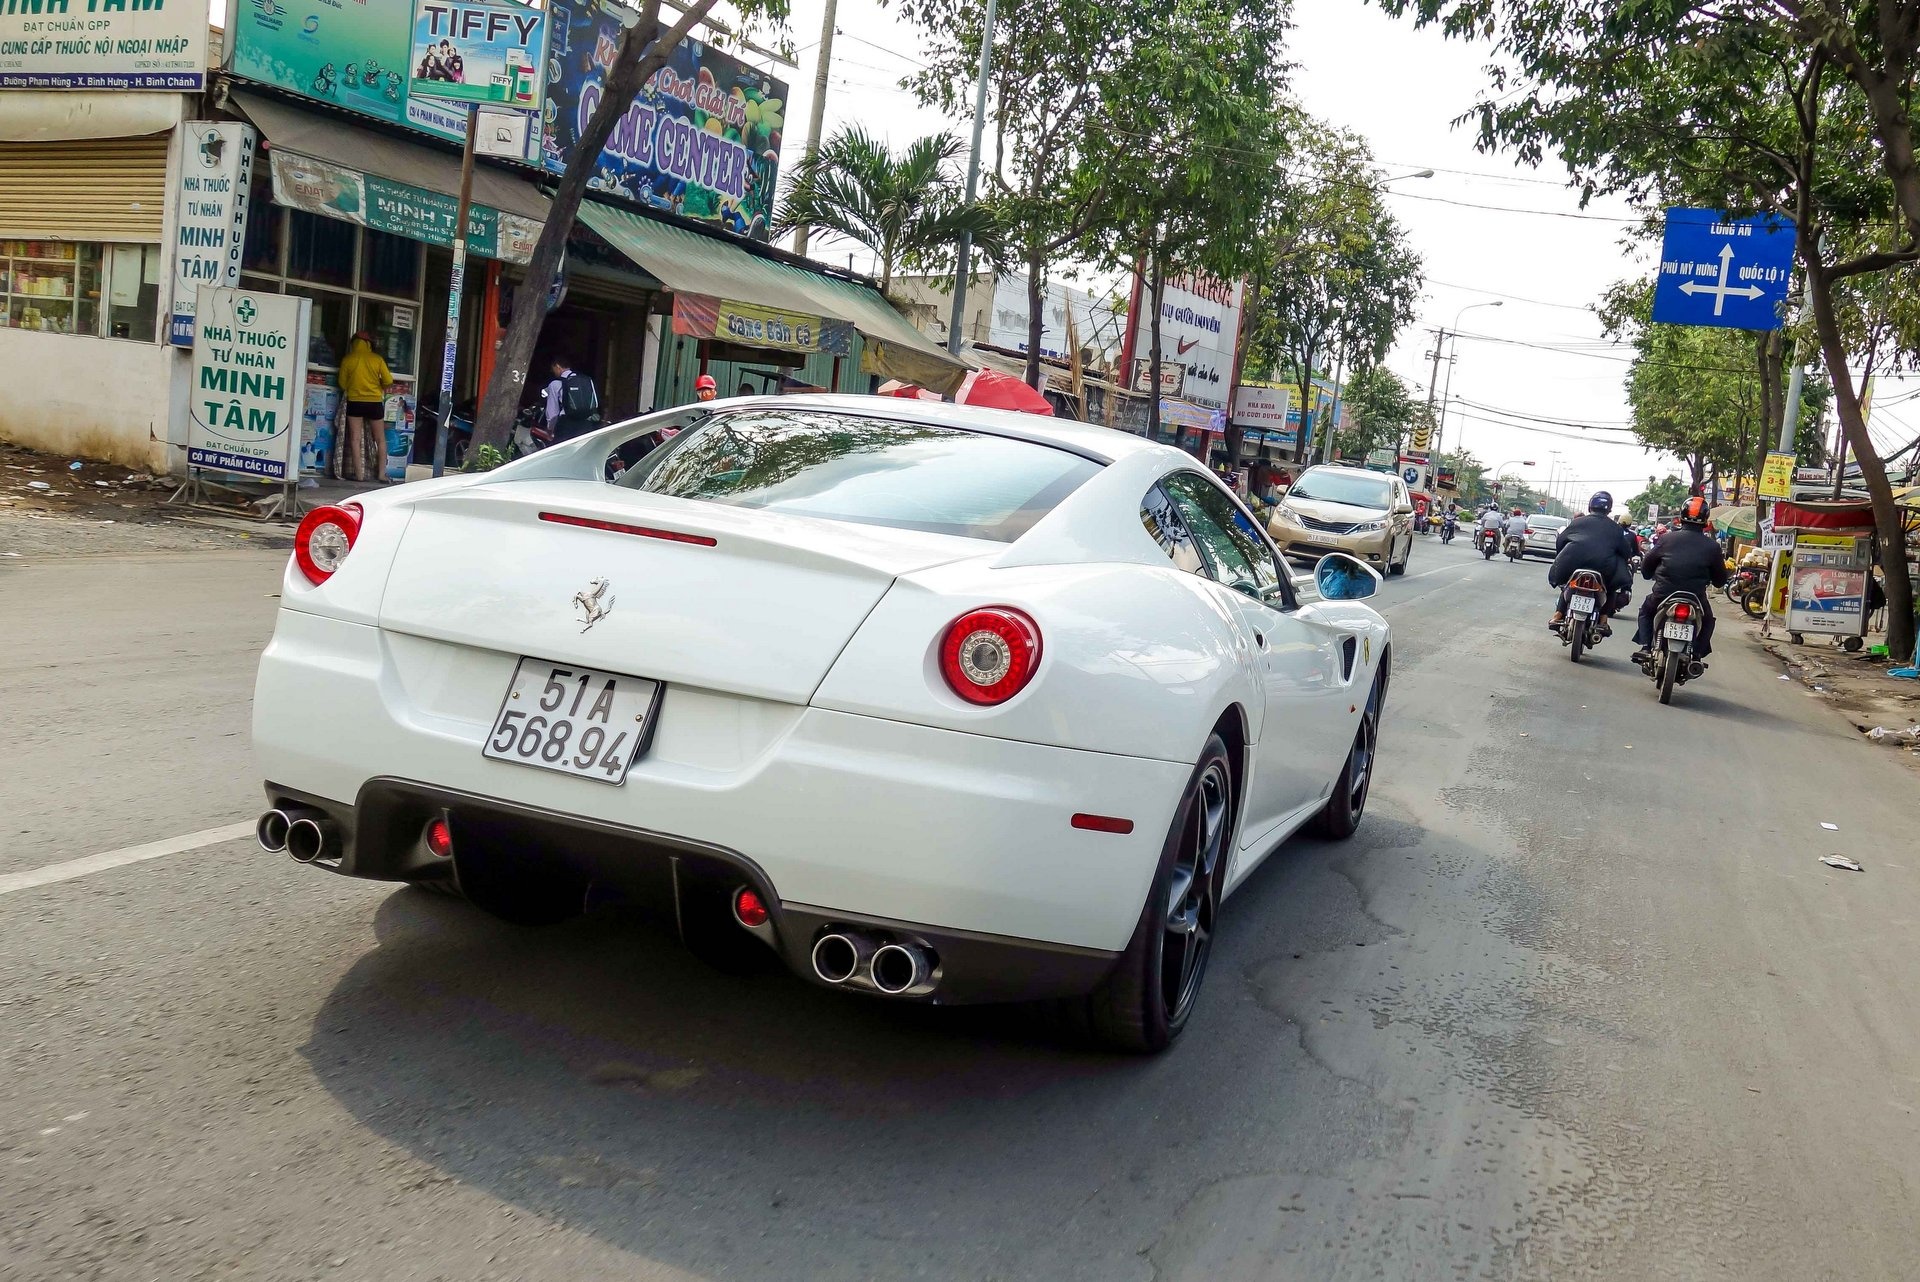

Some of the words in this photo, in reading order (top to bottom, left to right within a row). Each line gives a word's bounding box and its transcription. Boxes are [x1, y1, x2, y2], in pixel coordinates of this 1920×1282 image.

[23, 22, 44, 34] ĐẠT
[47, 16, 85, 32] CHUẨN
[87, 20, 111, 31] GPP
[424, 5, 540, 46] TIFFY
[1, 41, 28, 55] CUNG
[31, 36, 52, 54] CẤP
[55, 35, 92, 54] THUỐC
[94, 37, 114, 57] NỘI
[117, 39, 152, 57] NGOẠI
[155, 35, 189, 56] NHẬP
[52, 77, 71, 87] Hùng
[78, 77, 86, 86] X.
[88, 77, 106, 86] Bình
[136, 78, 144, 86] H.
[146, 76, 166, 86] Bình
[168, 77, 195, 86] Chánh
[492, 75, 513, 86] TIFFY
[660, 67, 694, 104] Chơi
[696, 84, 725, 118] Giải
[728, 97, 746, 126] Trí
[239, 137, 252, 185] NHÀ
[657, 117, 746, 199] CENTER
[184, 176, 200, 192] NHÀ
[202, 173, 230, 193] THUỐC
[188, 200, 200, 216] TƯ
[200, 200, 222, 217] NHÂN
[378, 198, 435, 224] MINH
[442, 213, 486, 237] TM
[180, 226, 225, 248] MINH
[228, 194, 246, 278] THUỐC
[1710, 222, 1736, 236] LONG
[1738, 223, 1752, 236] AN
[181, 254, 218, 280] TÂM
[1662, 260, 1678, 274] PHÚ
[1680, 260, 1694, 275] MỸ
[1696, 262, 1718, 277] HƯNG
[1739, 262, 1764, 280] QUỐC
[1766, 266, 1777, 284] LỘ
[1780, 270, 1784, 281] 1
[1162, 302, 1174, 324] NỤ
[1175, 307, 1194, 325] CƯỜI
[1194, 313, 1220, 334] DUYÊN
[203, 325, 232, 342] NHÀ
[238, 330, 287, 350] THUỐC
[796, 323, 812, 346] Cá
[212, 348, 231, 363] TƯ
[235, 351, 275, 370] NHÂN
[200, 366, 285, 401] MINH
[204, 398, 276, 435] TÂM
[224, 440, 251, 455] CHUẨN
[253, 448, 270, 458] GPP
[192, 449, 203, 462] CÓ
[204, 450, 218, 464] MỸ
[219, 452, 244, 468] PHẨM
[244, 458, 262, 472] CÁC
[263, 464, 282, 476] LOẠI
[1767, 476, 1786, 486] 3-5
[1572, 603, 1590, 612] 5765
[1668, 632, 1689, 640] 1523
[539, 668, 617, 724] 51A
[492, 710, 628, 776] 568.94
